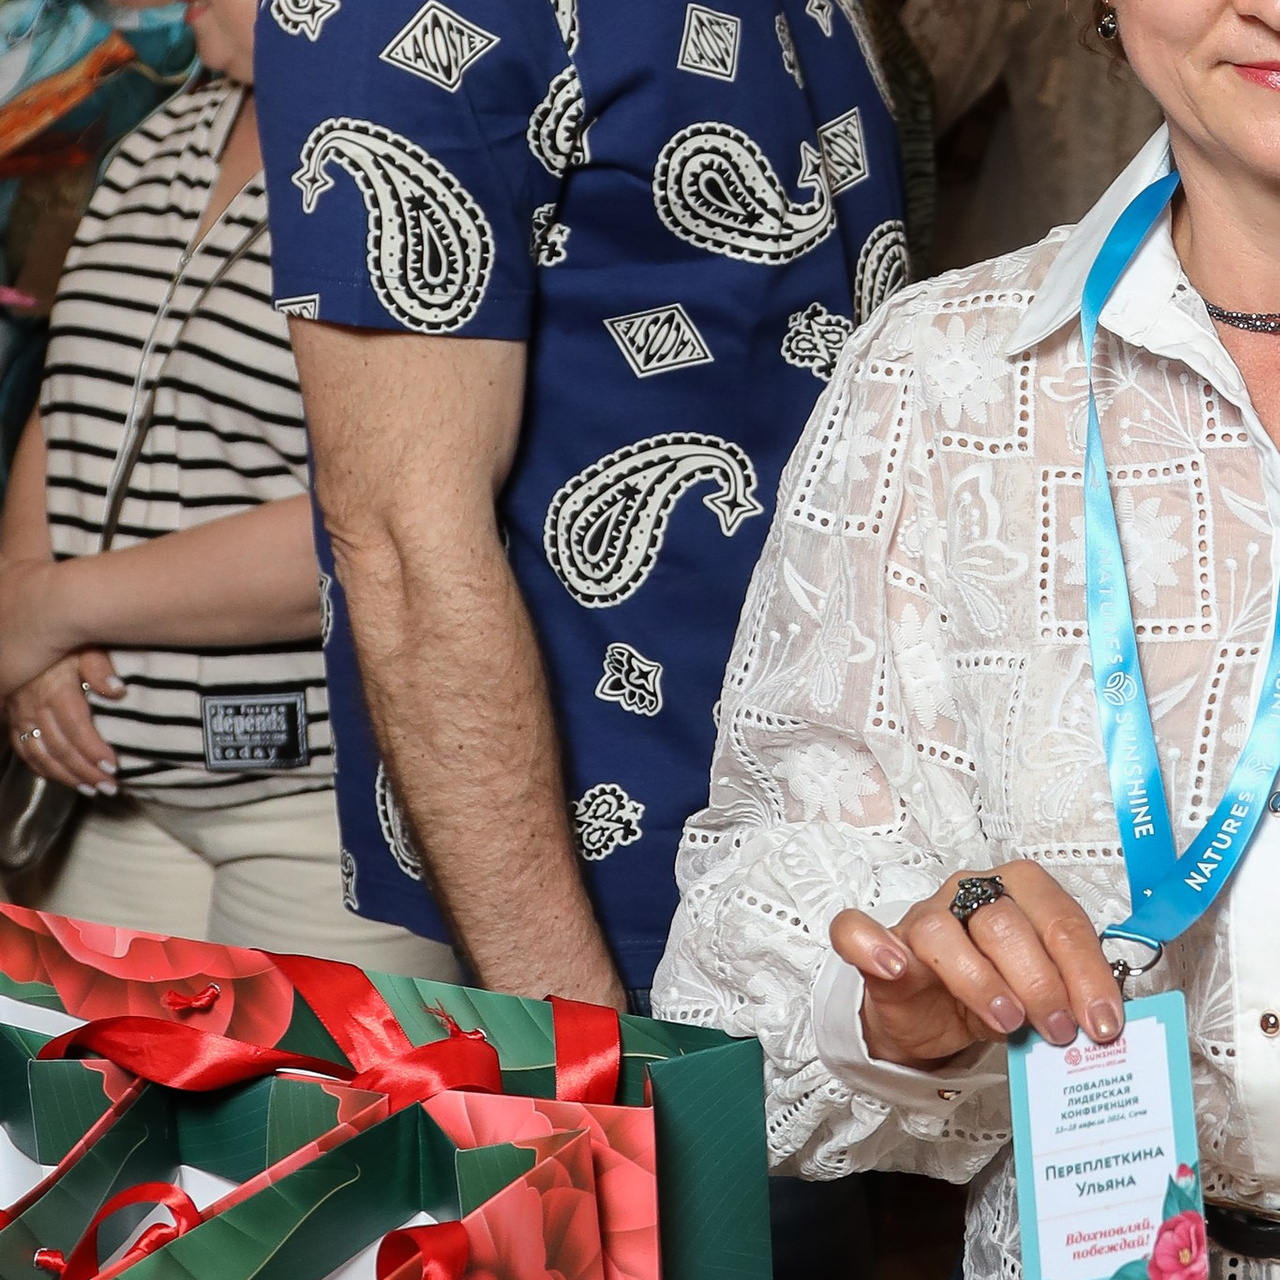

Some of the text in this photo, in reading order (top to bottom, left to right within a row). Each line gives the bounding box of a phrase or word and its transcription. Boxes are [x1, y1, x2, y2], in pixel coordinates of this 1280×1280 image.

[401, 11, 476, 81] LACOSTE
[688, 13, 733, 71] LACOSTE
[621, 312, 697, 367] LACOSTE
[1099, 547, 1154, 840] NATURES SUNSHINE
[1184, 790, 1254, 891] NATURES
[1063, 1072, 1133, 1095] ГЛОБАЛЬНАЯ
[1067, 1086, 1131, 1107] ЛИДЕРСКАЯ
[1061, 1096, 1139, 1120] КОНФЕРЕНЦИЯ
[1065, 1218, 1154, 1246] Вдохновляй,
[1072, 1234, 1150, 1260] побеждай!
